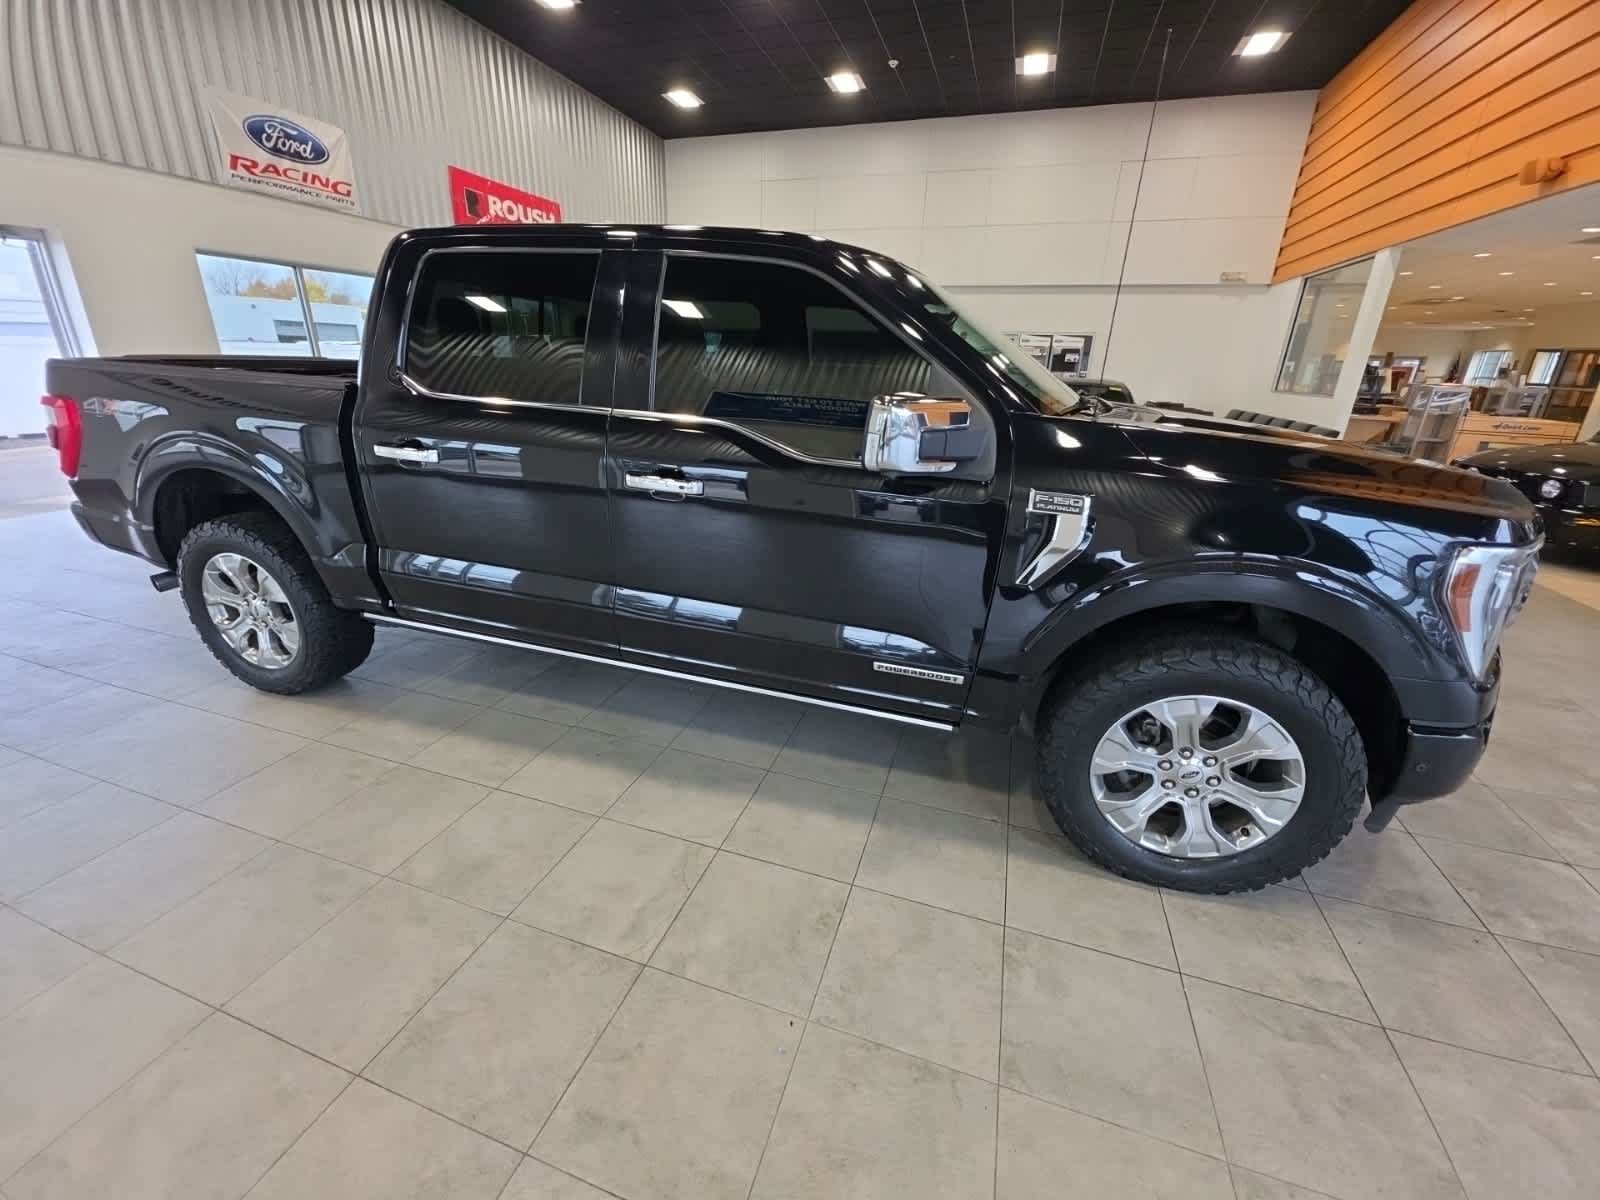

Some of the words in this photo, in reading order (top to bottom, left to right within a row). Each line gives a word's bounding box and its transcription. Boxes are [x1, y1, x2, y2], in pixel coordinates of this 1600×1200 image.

[261, 121, 314, 159] Ford
[229, 154, 353, 197] RACING
[231, 172, 321, 198] PERFORMANCE
[325, 194, 356, 207] PARTS
[487, 194, 555, 224] ROUSH
[1035, 494, 1083, 507] F-150
[1036, 503, 1080, 513] PLATINUM
[876, 664, 960, 683] POWERBOOST
